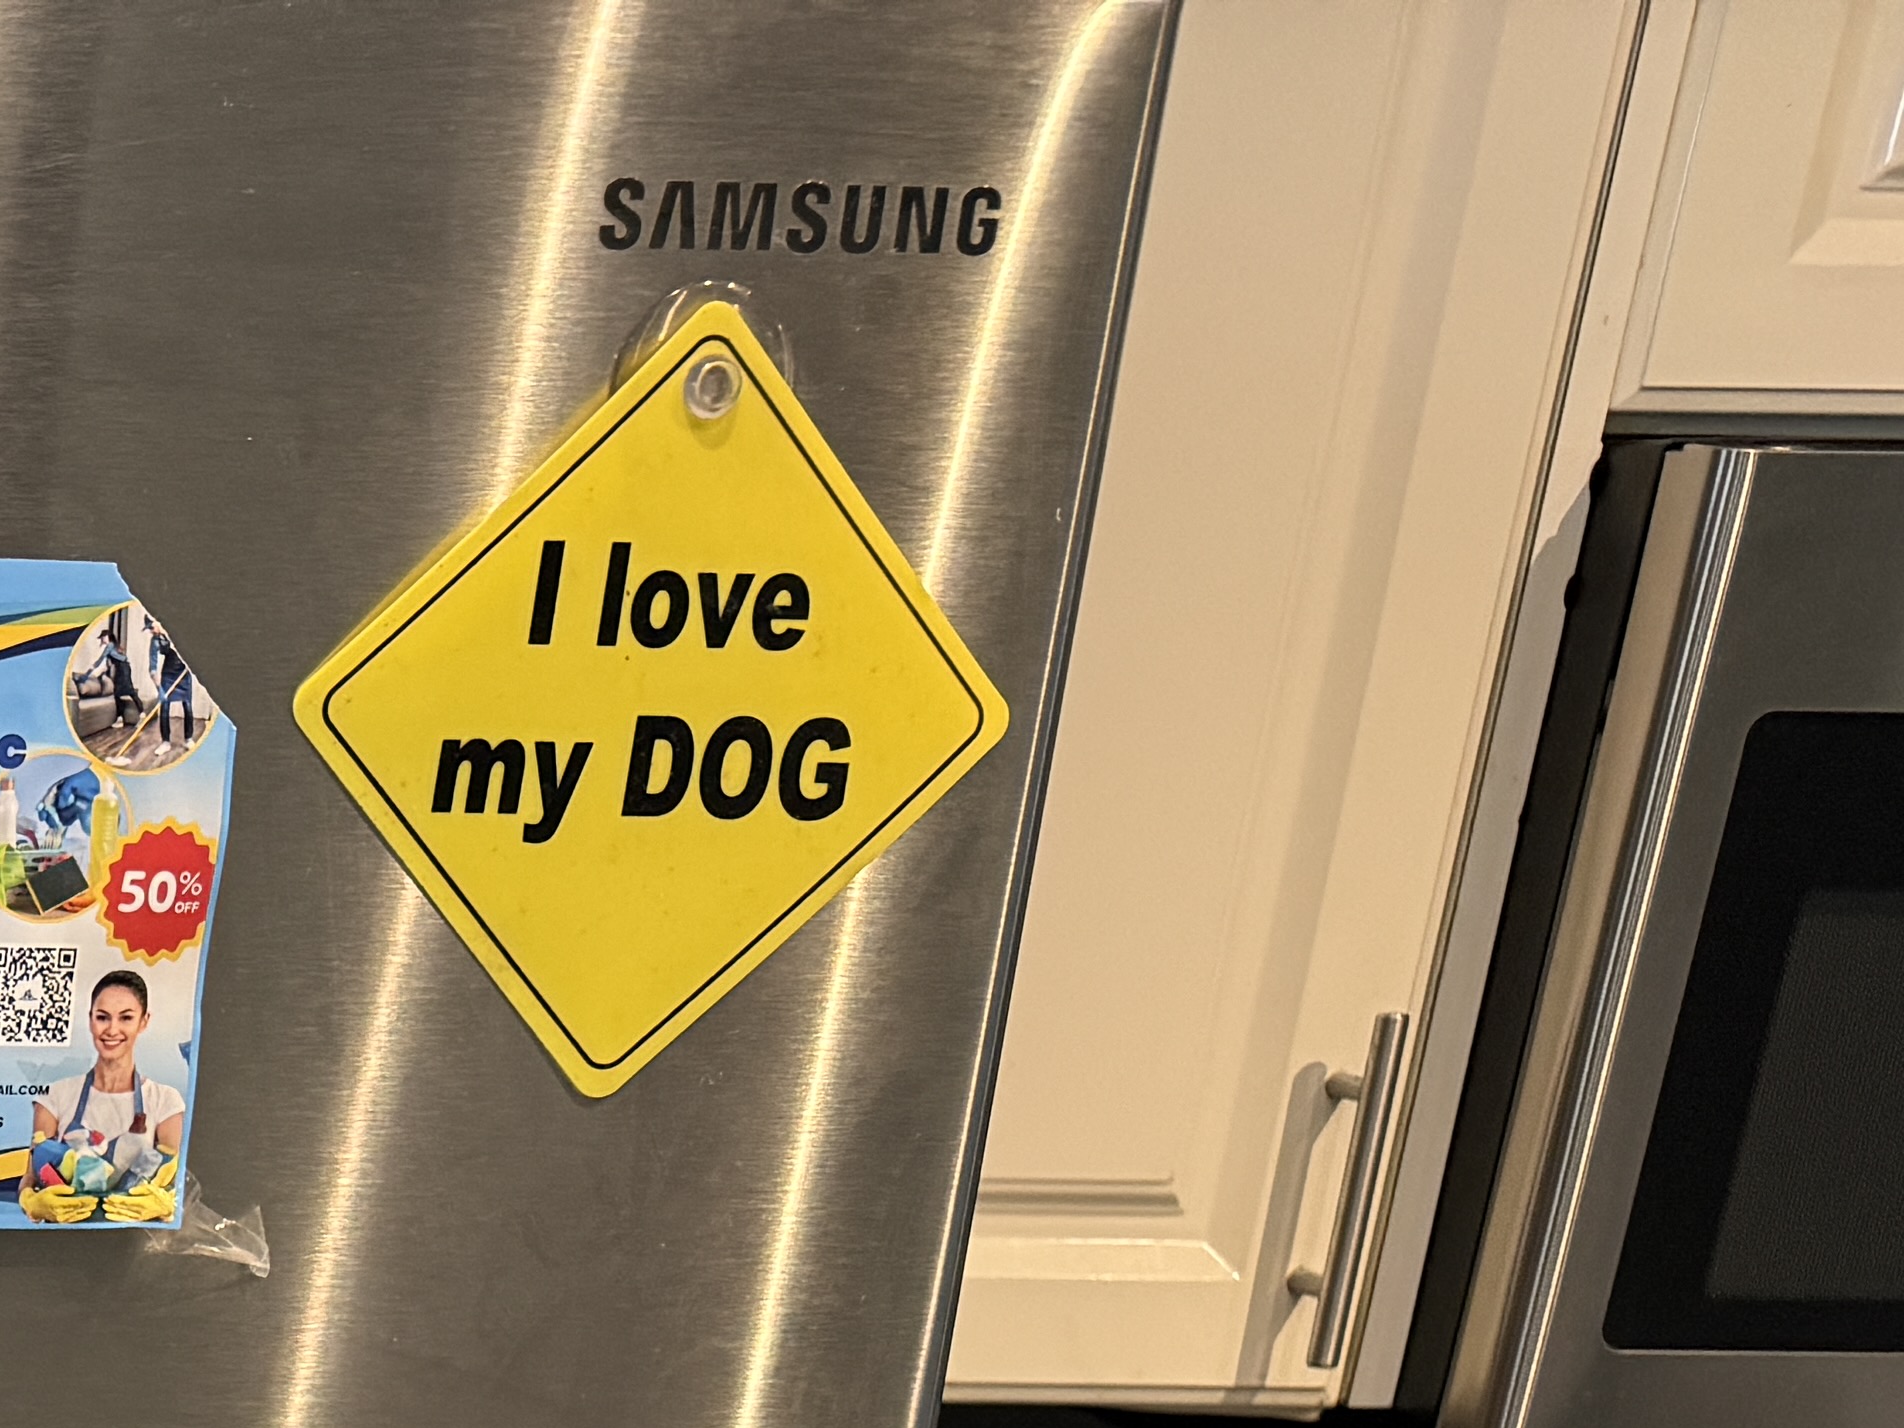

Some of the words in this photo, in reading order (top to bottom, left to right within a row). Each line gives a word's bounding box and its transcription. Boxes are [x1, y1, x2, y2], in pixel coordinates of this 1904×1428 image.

[598, 176, 1003, 257] SAMSUNG
[528, 539, 566, 646] I
[596, 541, 811, 653] love
[430, 736, 594, 845] my
[621, 714, 852, 822] DOG
[174, 901, 200, 914] OFF
